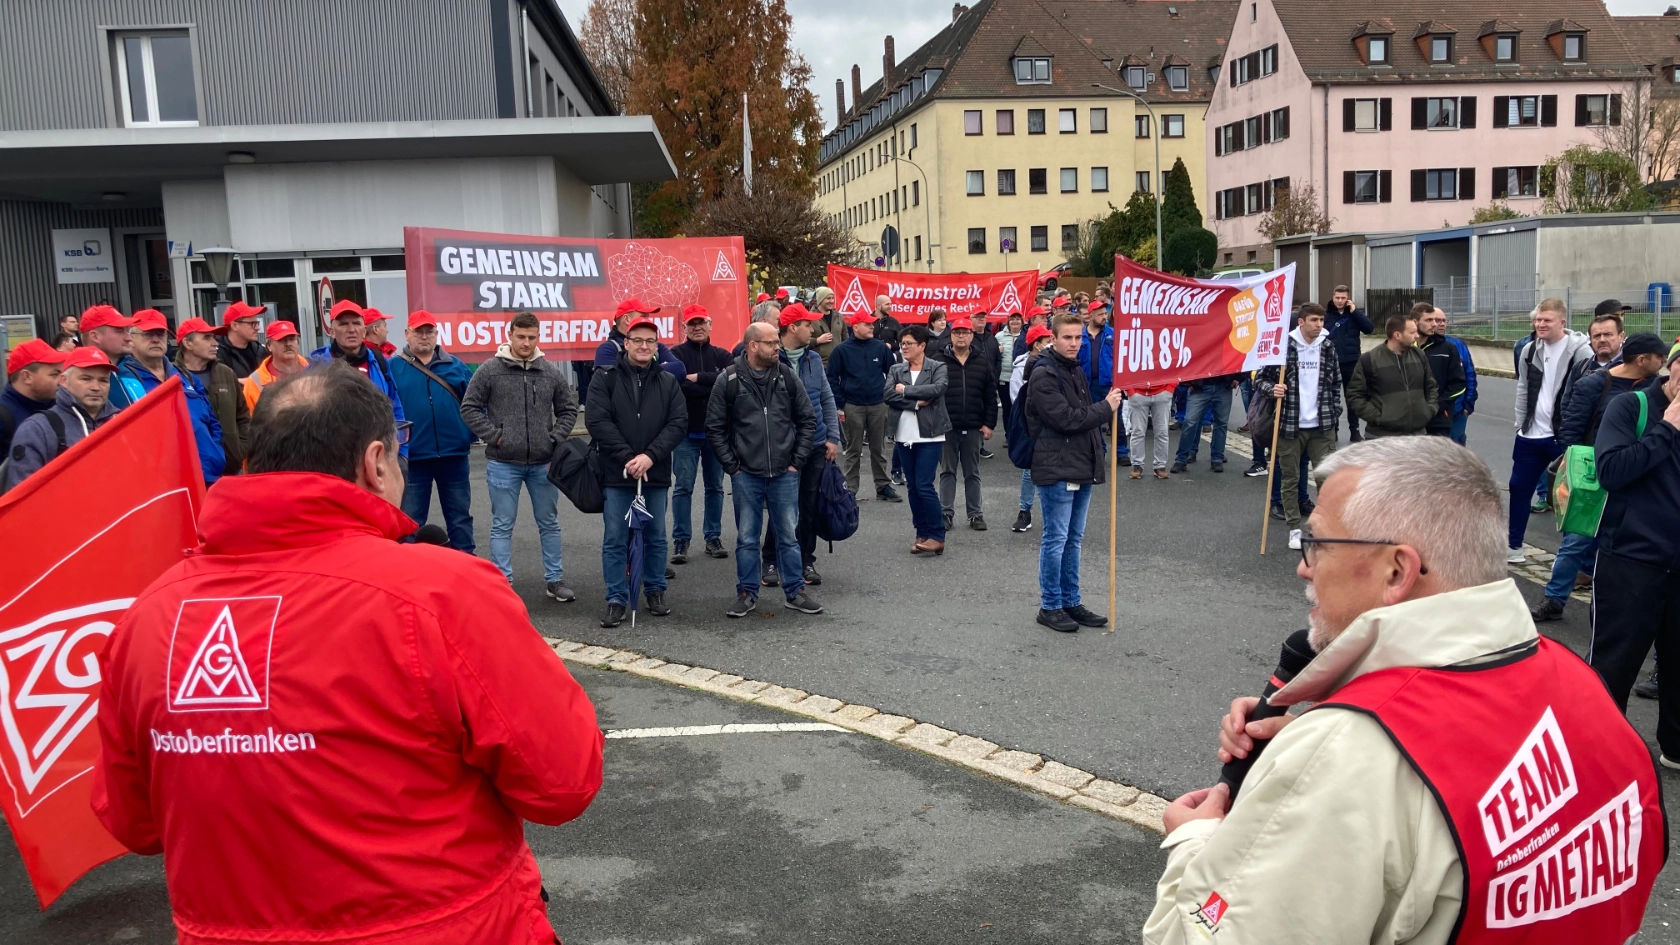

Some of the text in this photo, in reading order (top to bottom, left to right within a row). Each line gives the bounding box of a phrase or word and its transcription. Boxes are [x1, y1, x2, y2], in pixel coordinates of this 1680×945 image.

[64, 249, 83, 257] KSB
[440, 246, 599, 278] GEMEINSAM
[478, 280, 569, 310] STARK
[888, 282, 984, 301] Warnstreik
[1120, 276, 1226, 316] GEMEINSAM
[890, 303, 916, 313] nser
[917, 303, 947, 316] gutes
[436, 316, 675, 346] N OSTERFRAN!
[1118, 317, 1192, 374] FÜR 8%
[1484, 728, 1571, 845] TEAM
[1496, 821, 1560, 873] Ostoberfranken
